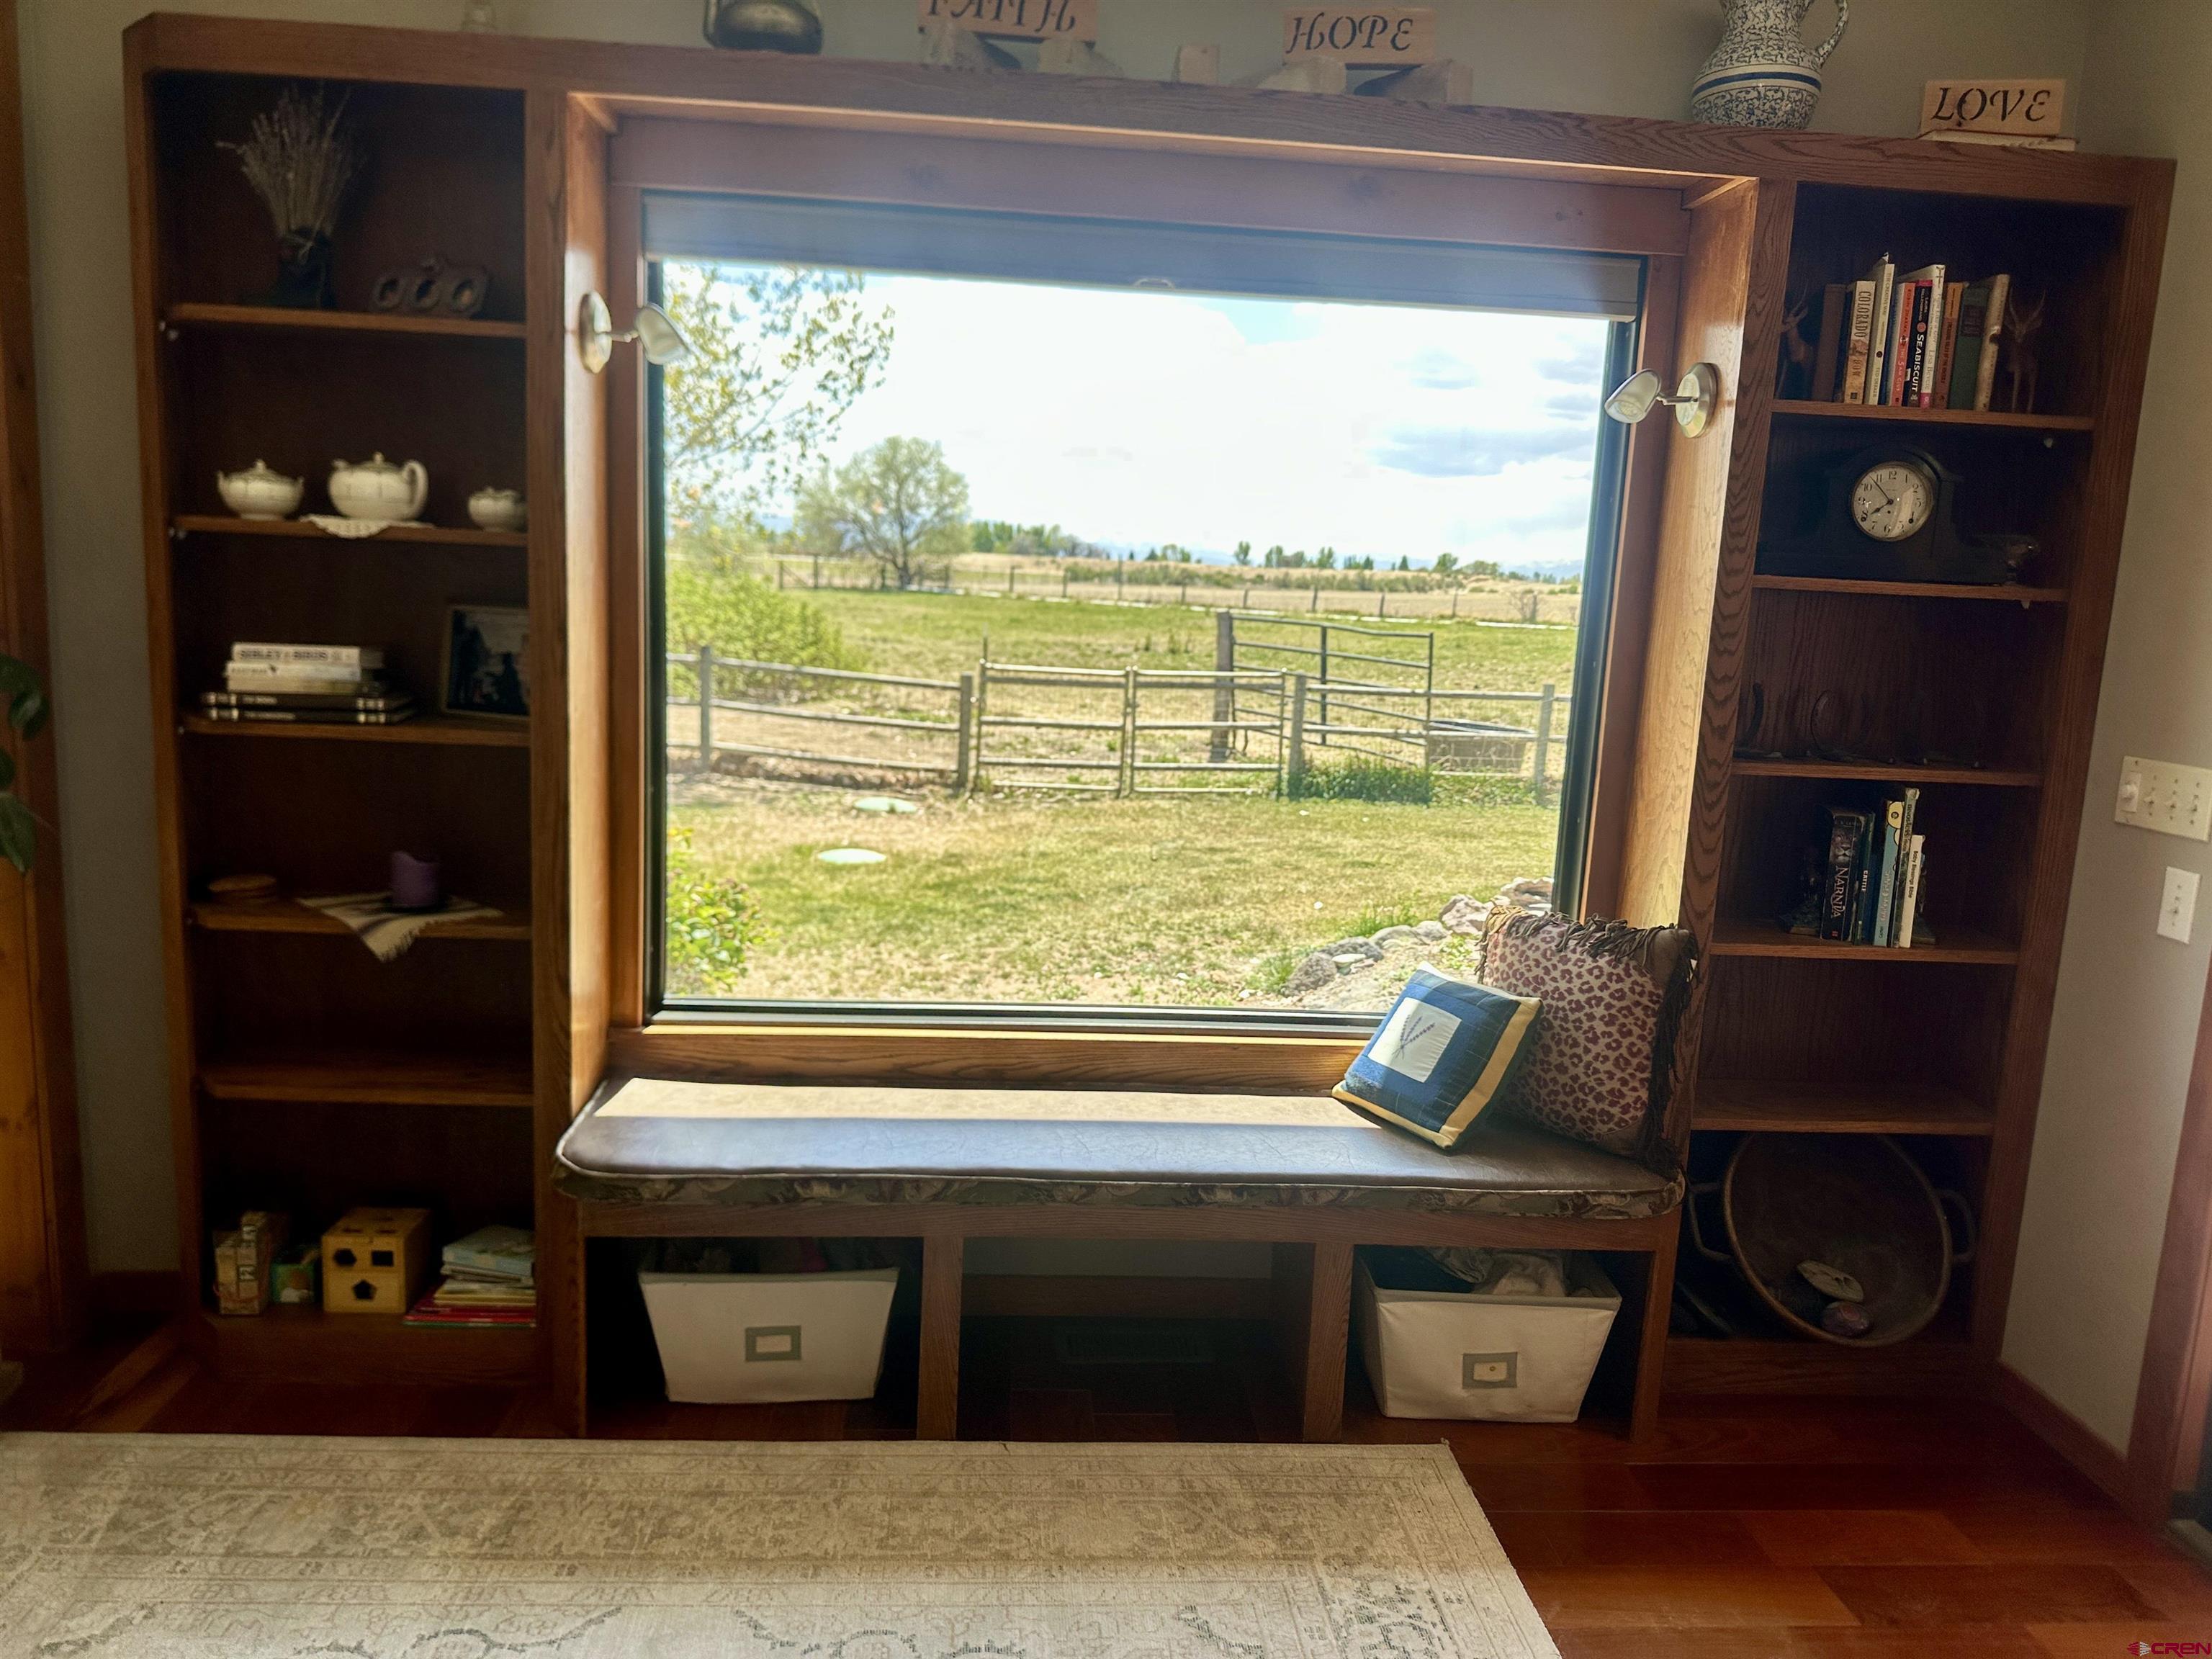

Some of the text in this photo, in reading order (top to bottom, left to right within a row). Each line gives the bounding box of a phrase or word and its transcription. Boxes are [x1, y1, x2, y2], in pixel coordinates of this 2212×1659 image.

[1285, 12, 1413, 54] HOPE
[1930, 87, 2051, 122] LOVE
[1854, 291, 1871, 338] COLORADO
[1912, 334, 1925, 392] SEABISCUIT
[1889, 470, 1897, 480] 12
[1912, 483, 1919, 493] 2
[1830, 865, 1850, 919] NARNIA
